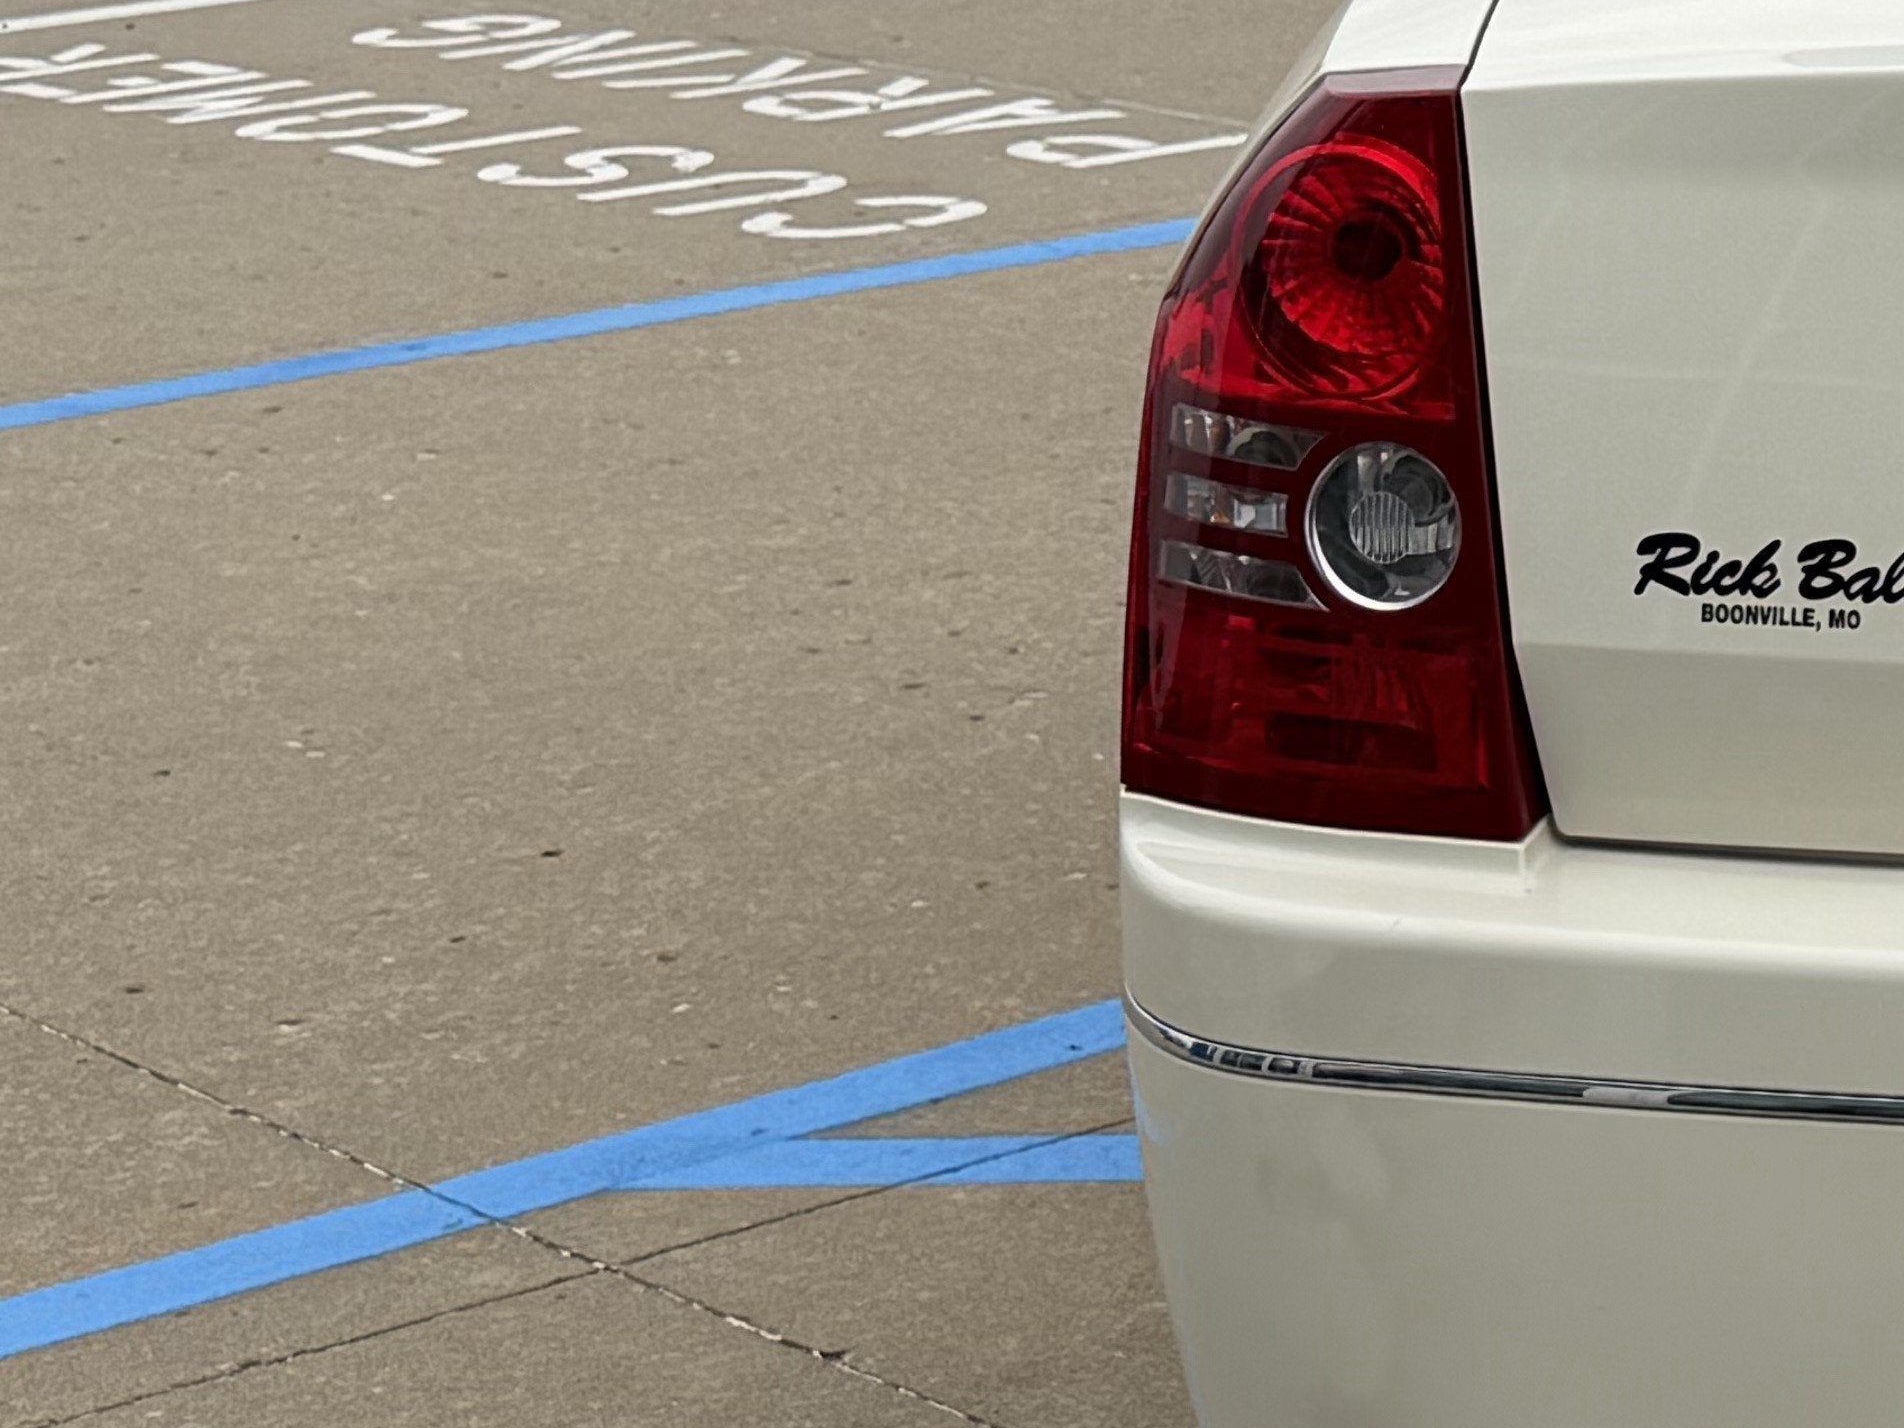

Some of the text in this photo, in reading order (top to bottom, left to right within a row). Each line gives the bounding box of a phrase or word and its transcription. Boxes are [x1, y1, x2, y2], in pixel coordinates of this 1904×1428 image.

[0, 43, 987, 238] CUSTOMER
[351, 14, 1248, 169] PARKING
[1634, 532, 1781, 599] Rick
[1701, 603, 1861, 632] BOONVILLE, MO
